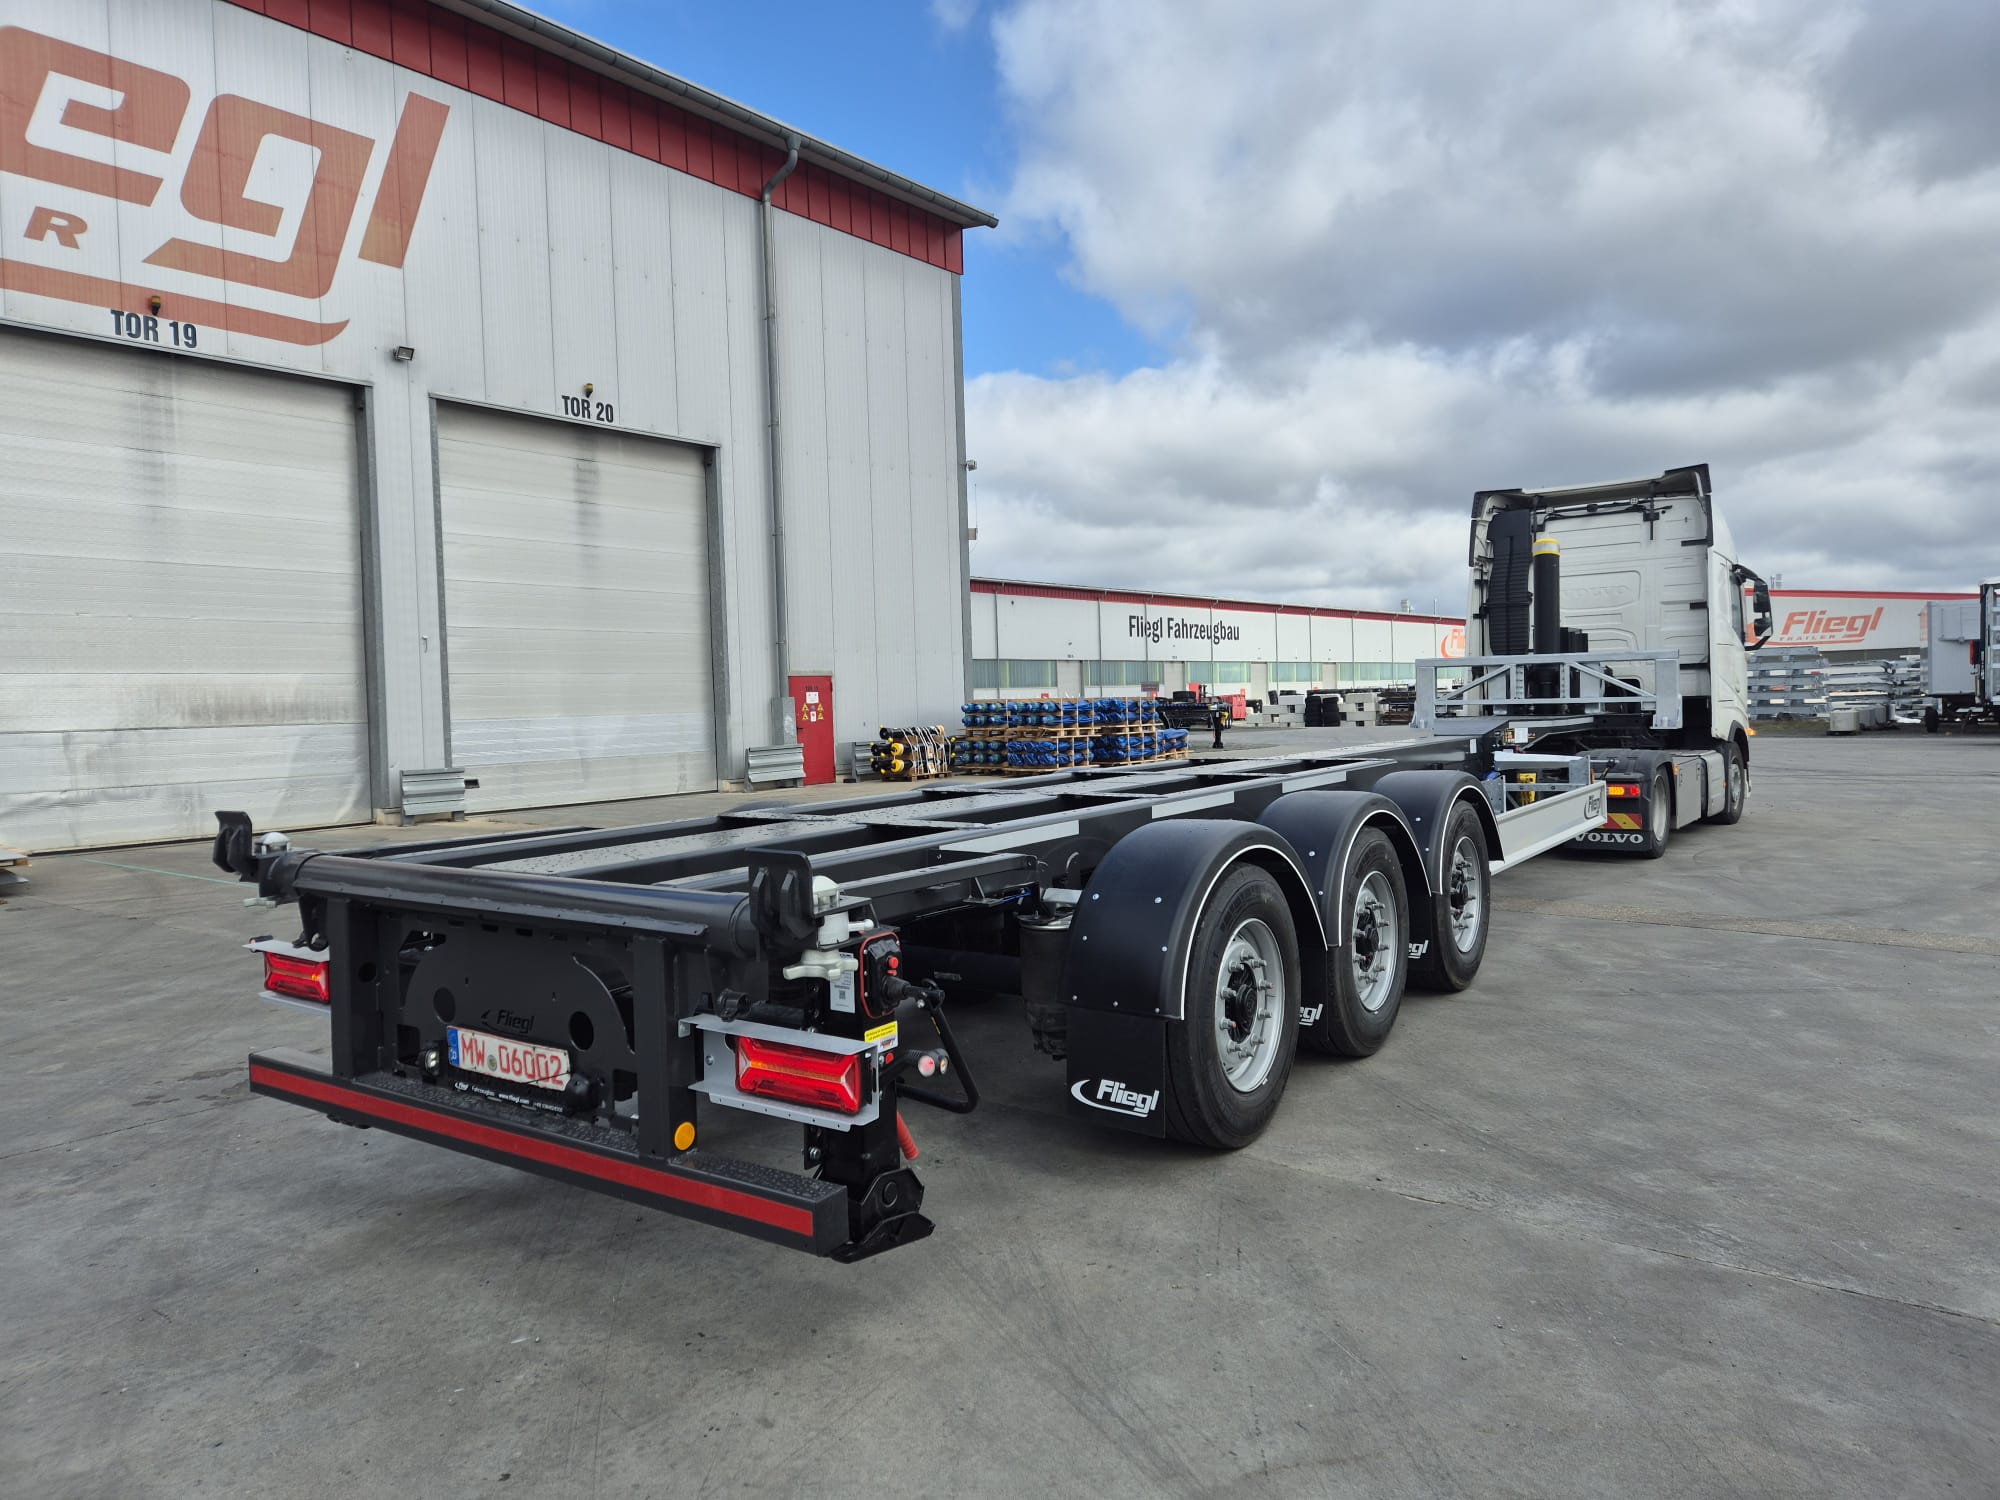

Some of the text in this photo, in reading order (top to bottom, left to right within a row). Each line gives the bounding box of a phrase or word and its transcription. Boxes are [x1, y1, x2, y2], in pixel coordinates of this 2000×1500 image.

[110, 309, 197, 348] TOR 19
[561, 395, 614, 423] TOR 20
[1129, 615, 1240, 645] Fliegl Fahrzeugbau
[1781, 606, 1885, 639] Fliegl
[496, 1009, 535, 1034] Fliegl
[461, 1033, 486, 1068] MW
[498, 1045, 564, 1086] 06002
[1096, 1079, 1160, 1114] Fliegl
